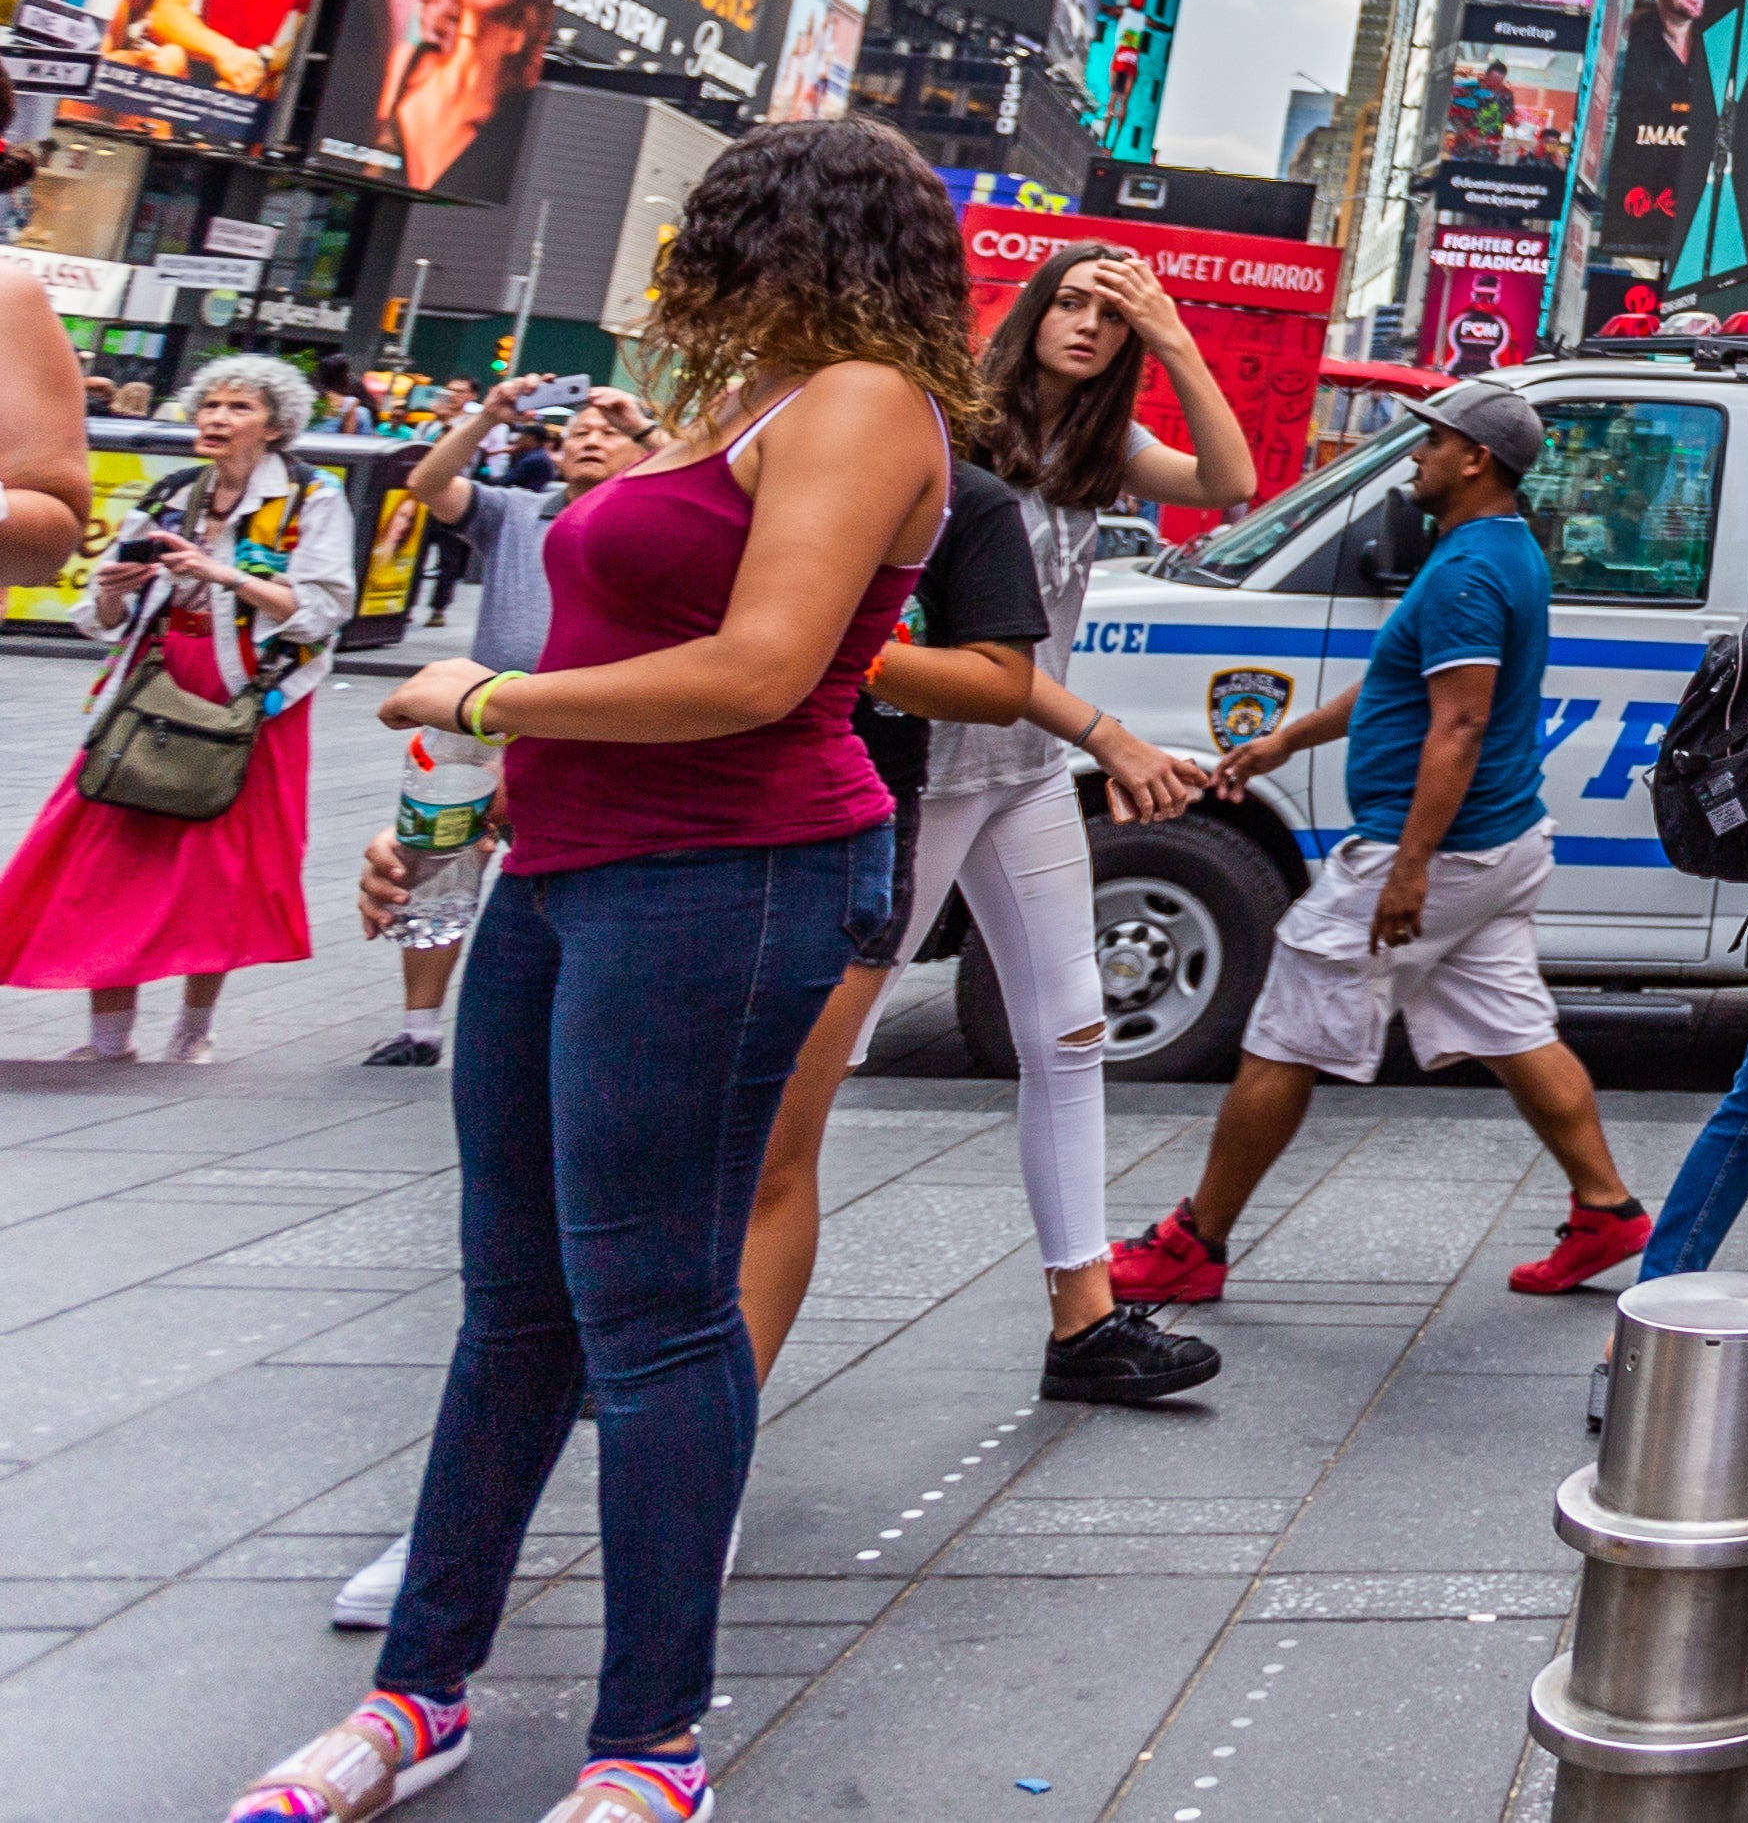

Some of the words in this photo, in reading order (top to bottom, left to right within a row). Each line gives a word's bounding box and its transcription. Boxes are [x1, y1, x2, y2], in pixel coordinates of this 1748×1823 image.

[1443, 233, 1514, 254] FIGHTER
[1516, 239, 1543, 257] OF
[1157, 249, 1224, 282] SWEET
[1229, 260, 1324, 294] CHURROS
[1469, 254, 1550, 275] RADICALS
